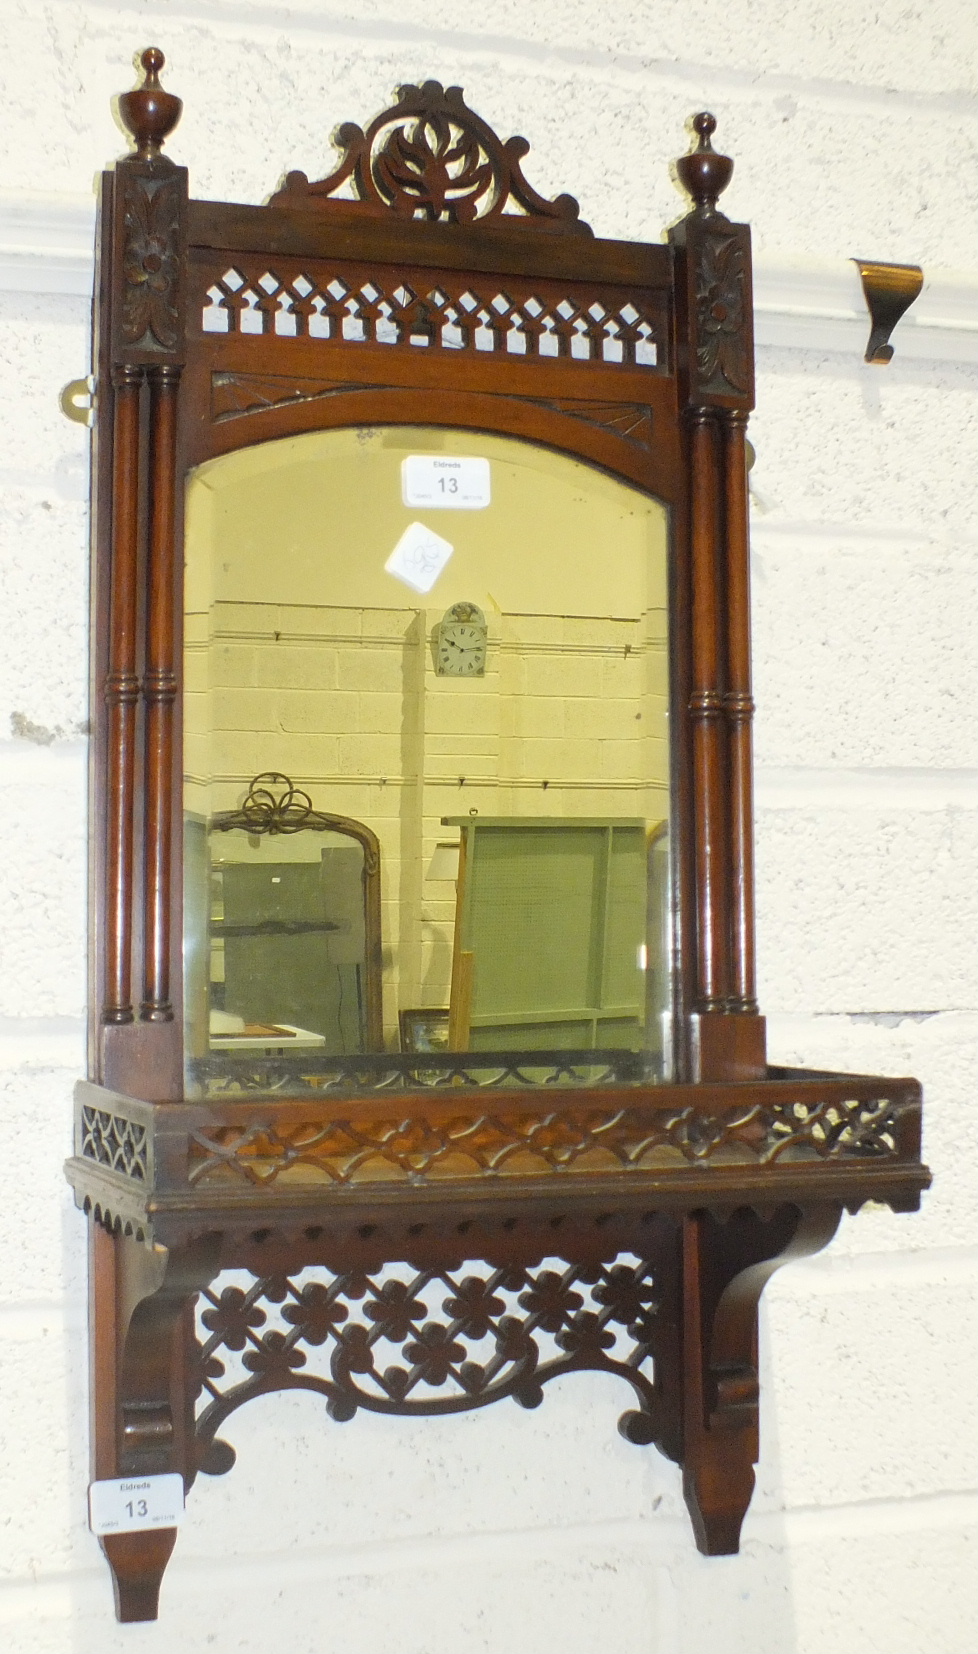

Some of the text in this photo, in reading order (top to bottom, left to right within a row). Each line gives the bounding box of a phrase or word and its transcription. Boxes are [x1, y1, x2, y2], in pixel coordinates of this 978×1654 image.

[433, 461, 461, 469] Eldreds
[438, 477, 459, 494] 13
[120, 1482, 151, 1491] Eldreds
[126, 1499, 149, 1518] 13
